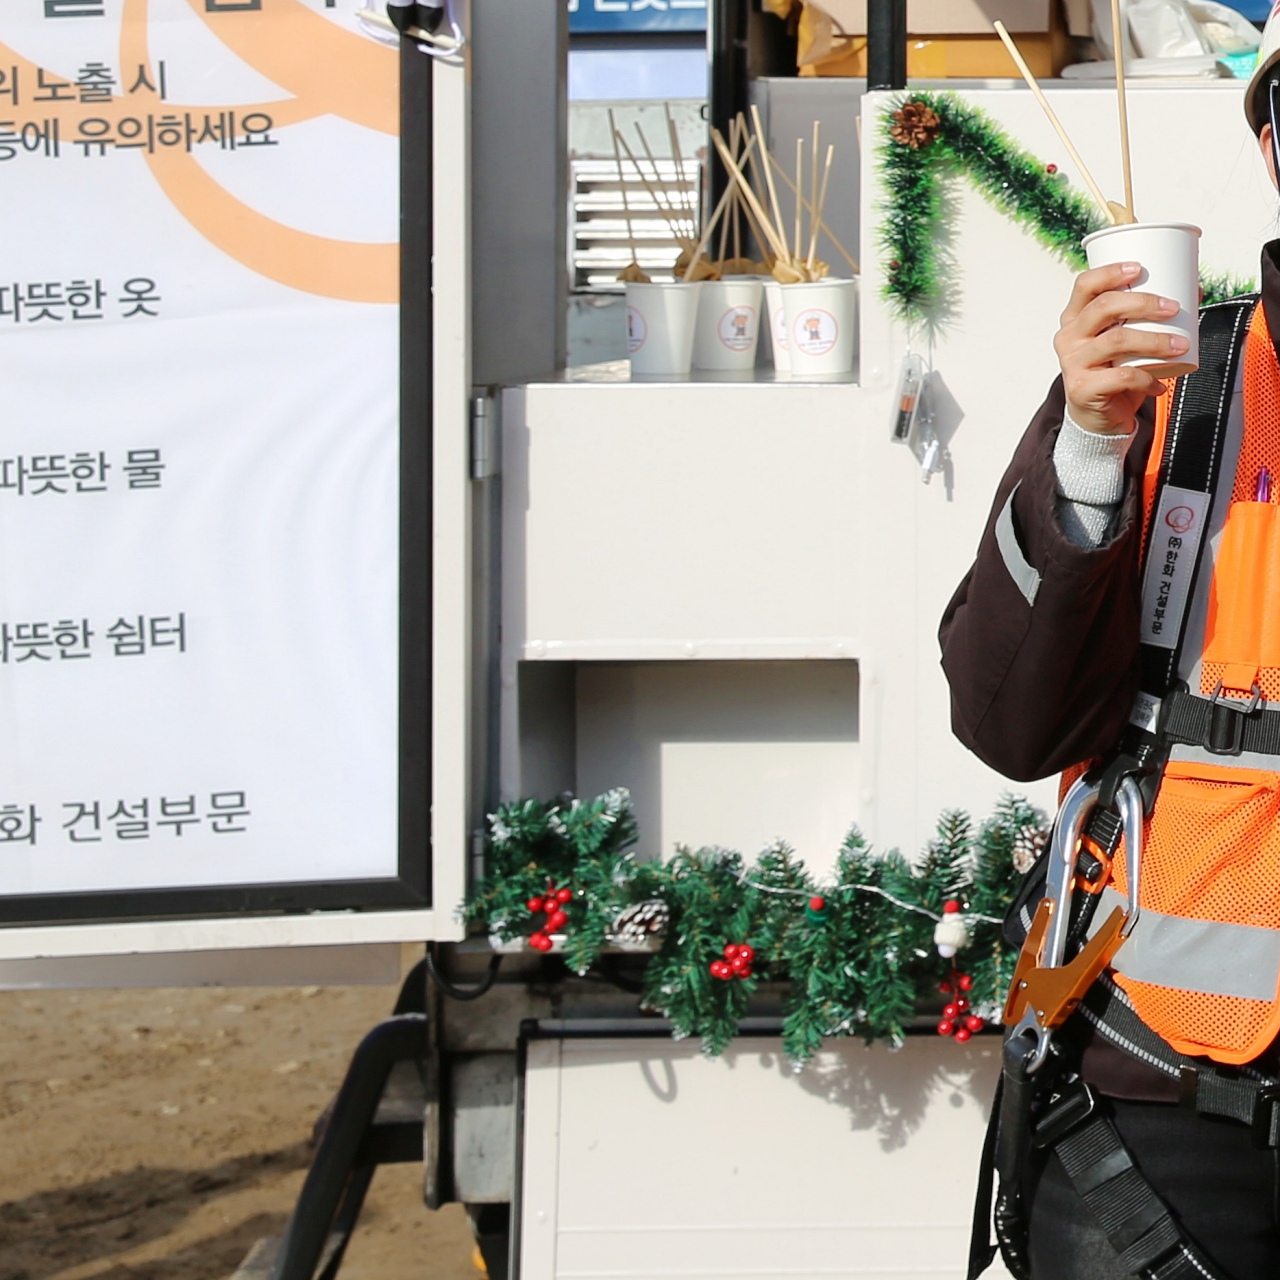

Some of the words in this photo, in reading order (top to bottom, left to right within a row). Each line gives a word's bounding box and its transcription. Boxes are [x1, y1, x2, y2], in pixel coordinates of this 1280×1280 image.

[33, 62, 117, 103] 노출
[129, 60, 167, 100] 시
[73, 111, 279, 157] 유의하세요
[118, 277, 161, 318] 옷
[122, 448, 166, 489] 물
[106, 612, 186, 656] 쉼터
[61, 790, 251, 842] 건설부문
